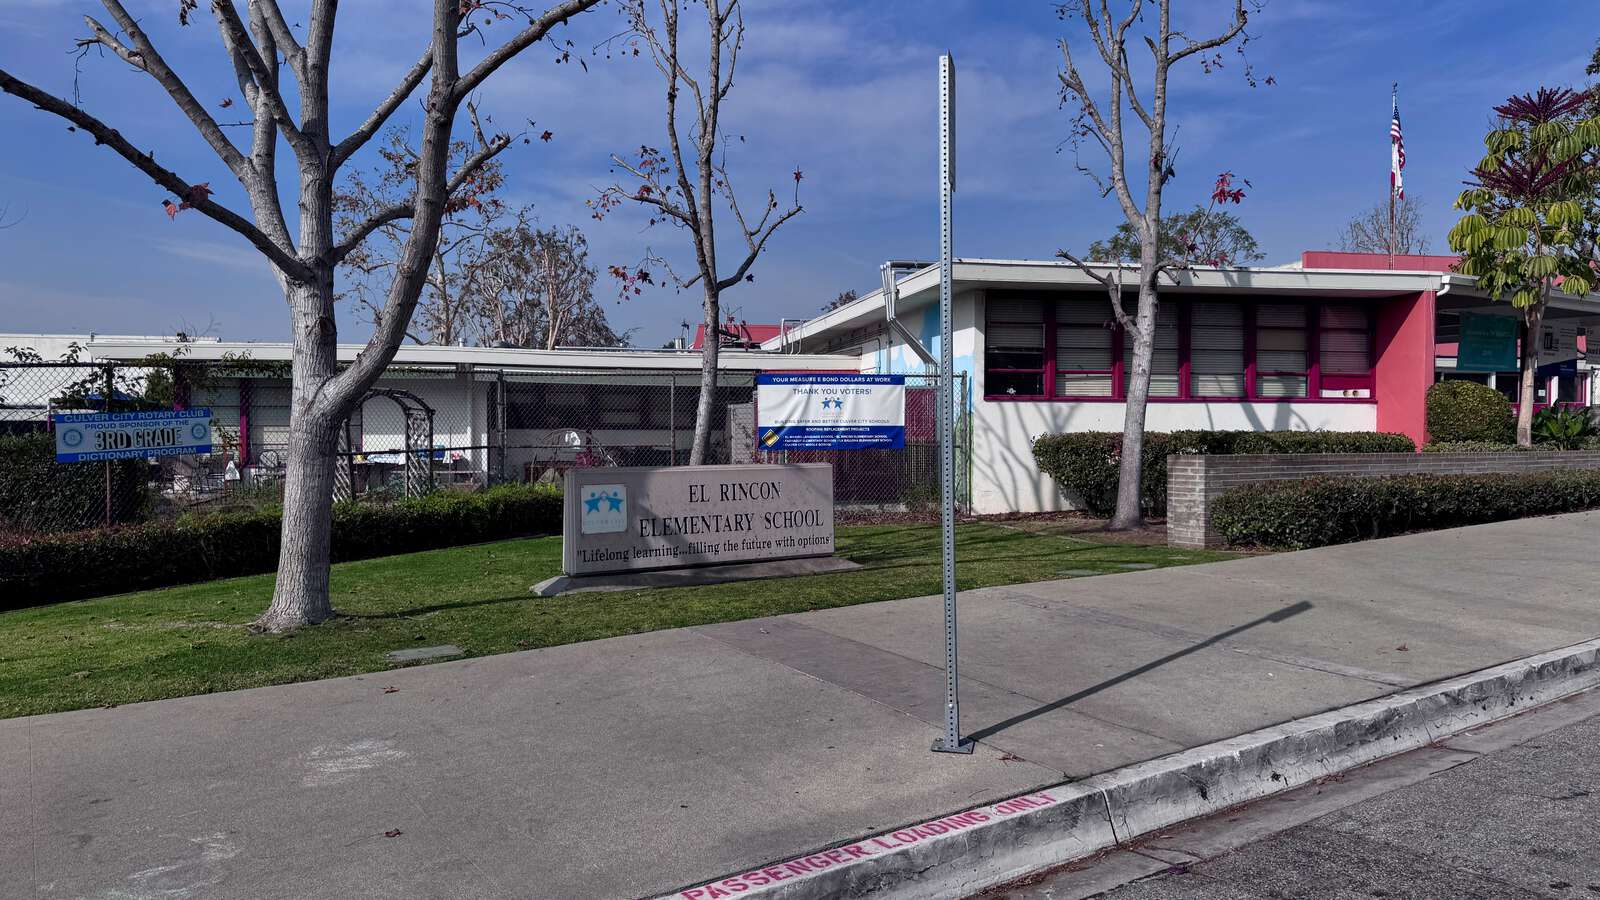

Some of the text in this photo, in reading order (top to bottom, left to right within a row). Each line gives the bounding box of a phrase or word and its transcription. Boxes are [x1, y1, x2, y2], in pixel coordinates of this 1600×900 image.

[64, 414, 109, 423] CULVER
[138, 411, 176, 420] ROTARY
[179, 410, 204, 418] CLUB
[95, 427, 183, 450] 3RD GRADE
[78, 447, 196, 461] DICTIONARY PROGRAM
[688, 482, 782, 503] EL RINCON
[640, 512, 754, 538] ELEMENTARY
[764, 509, 824, 530] SCHOOL
[578, 549, 629, 563] "Lifelong
[632, 541, 720, 559] learning...filling
[723, 540, 739, 552] the
[742, 537, 772, 550] future
[775, 536, 795, 548] with
[681, 792, 1058, 900] PASSENGER LOADING ONLY
